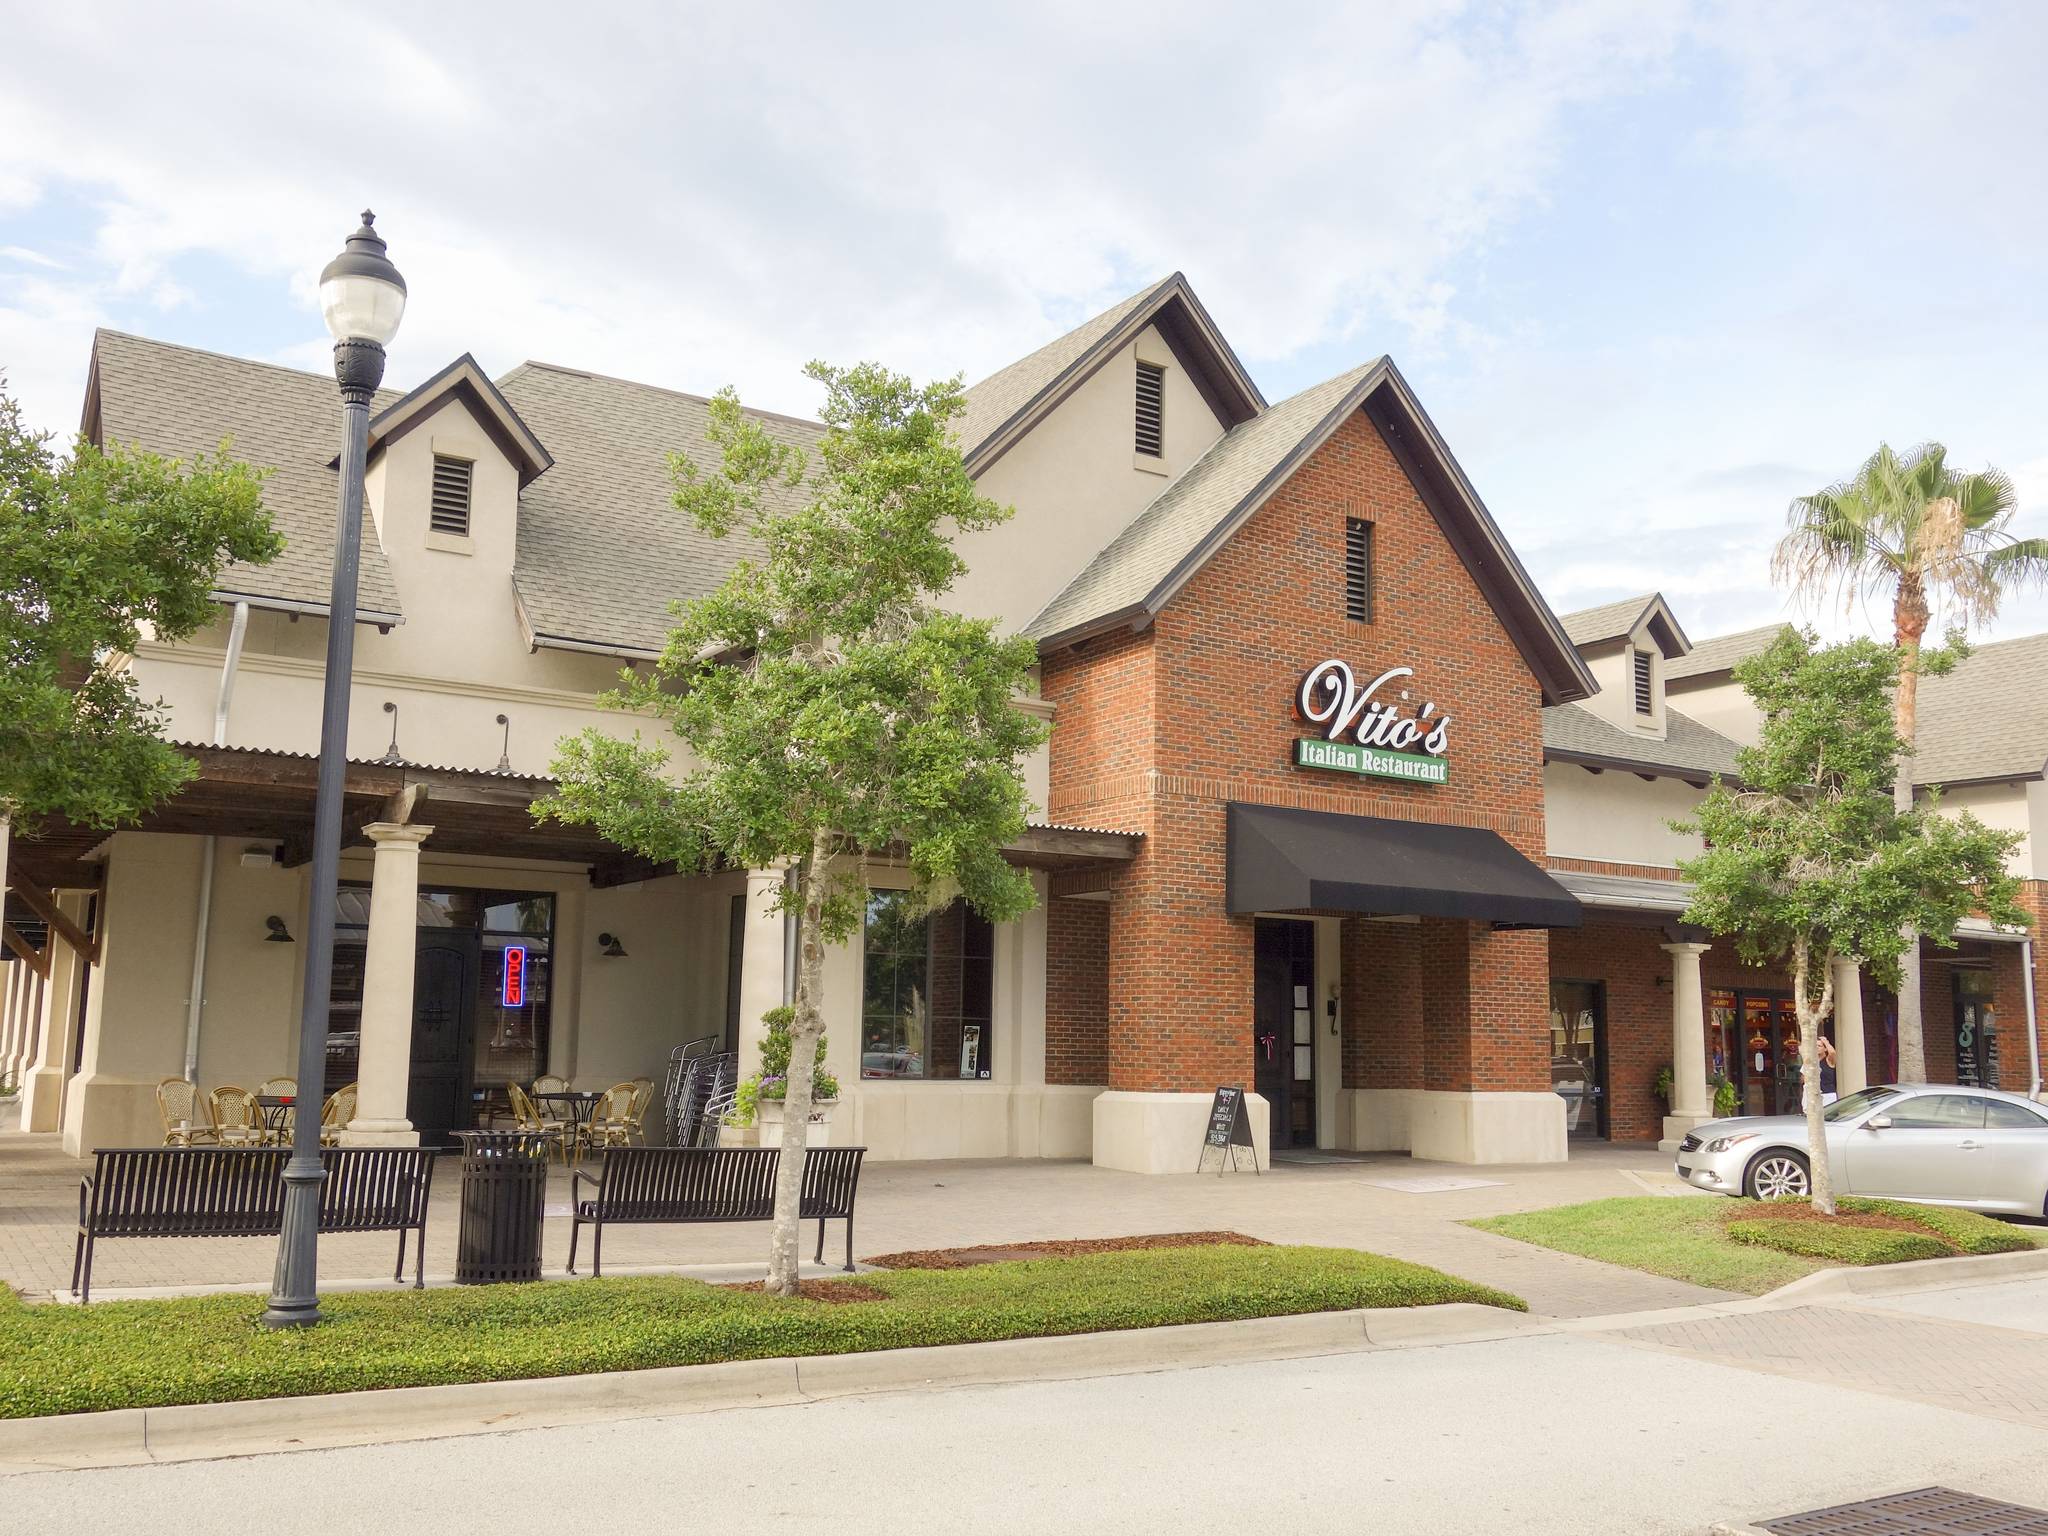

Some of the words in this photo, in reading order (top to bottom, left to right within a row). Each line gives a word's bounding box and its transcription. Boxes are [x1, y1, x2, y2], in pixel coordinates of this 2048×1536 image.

[1301, 659, 1451, 754] Vito's
[1301, 741, 1357, 768] Italian
[1361, 749, 1446, 781] Restaurant
[507, 949, 522, 1004] OPEN
